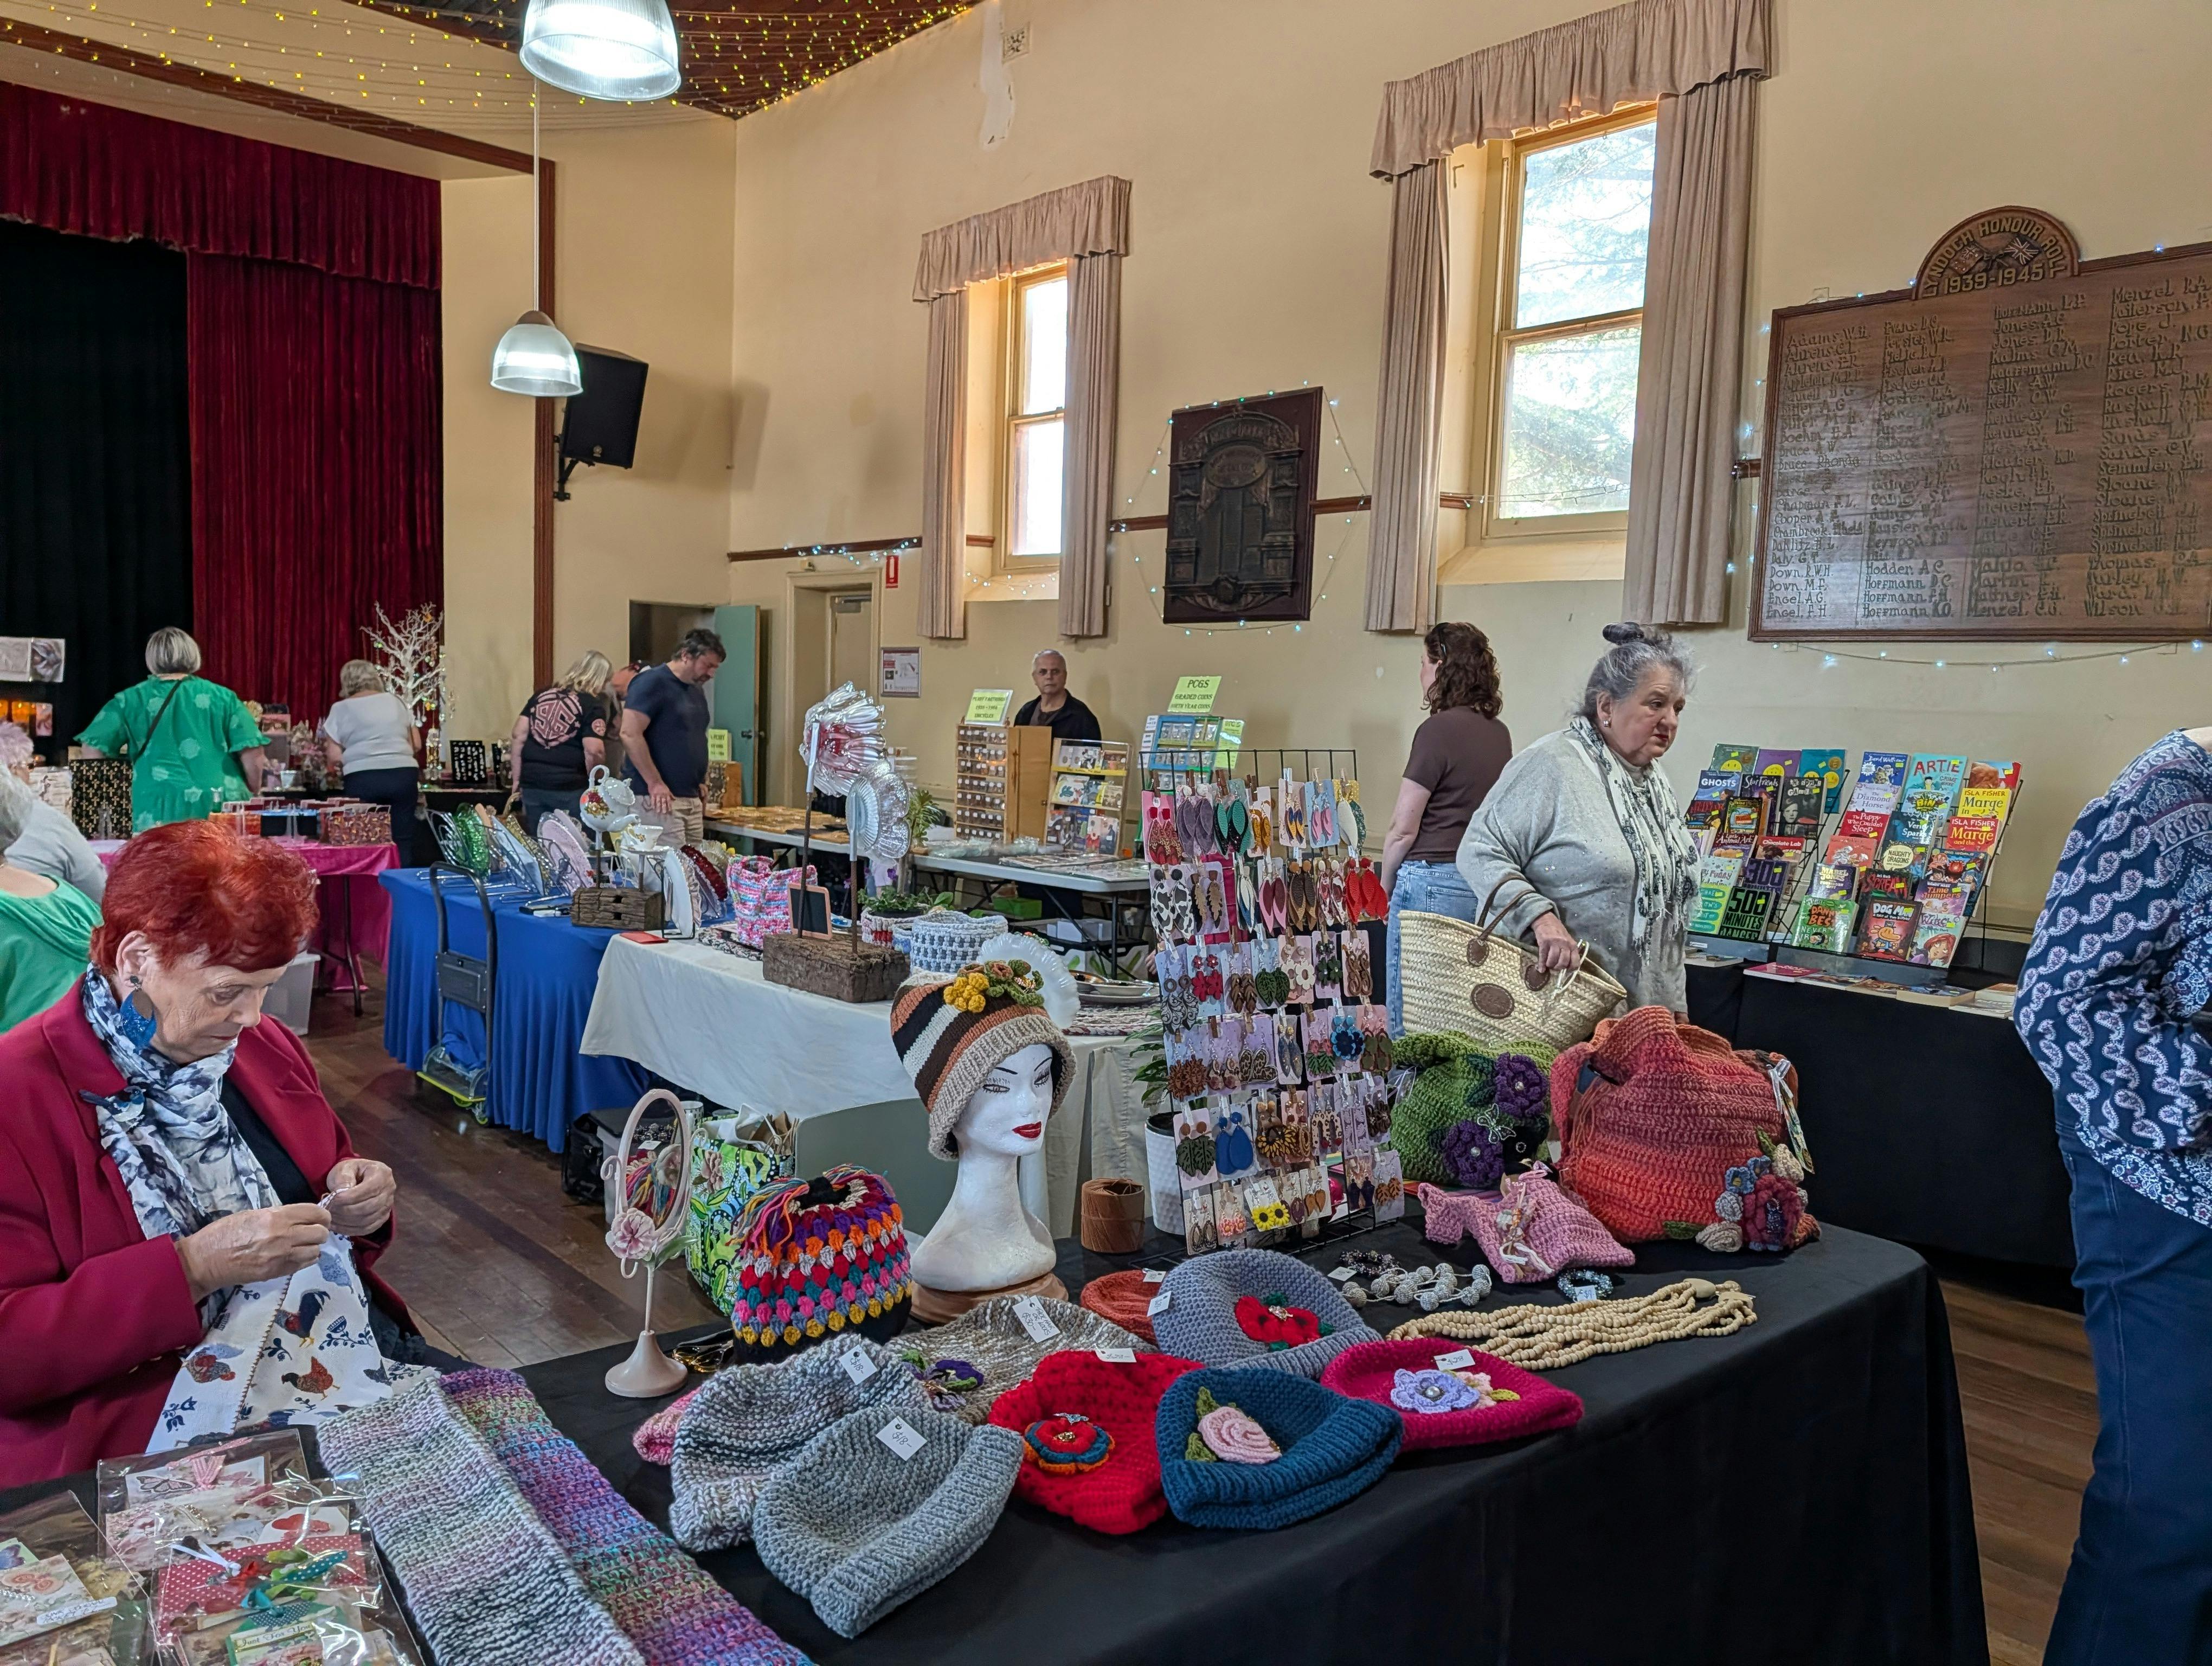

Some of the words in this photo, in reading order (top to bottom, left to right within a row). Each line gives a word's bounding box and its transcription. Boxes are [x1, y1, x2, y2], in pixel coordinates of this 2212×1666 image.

[1922, 230, 1974, 297] LYNDOCH
[1979, 217, 2044, 240] HONOUR
[2041, 236, 2066, 278] ROLL
[1944, 263, 2043, 294] 1939-1945
[1187, 679, 1210, 688] PCGS
[1913, 759, 1963, 777] ARTIE
[1701, 778, 1737, 787] GHOSTS
[1856, 793, 1891, 803] Diamond
[1862, 800, 1884, 809] Horse
[1962, 797, 2003, 811] Marge
[1860, 813, 1881, 822] Puppy
[1851, 825, 1873, 834] Sleep
[1950, 826, 1994, 844] Marge
[1888, 850, 1912, 858] NAUGHTY
[1728, 888, 1772, 915] 500
[1873, 902, 1893, 913] DOG
[1723, 912, 1763, 930] MINUTES
[1801, 925, 1828, 934] NEVER
[239, 1638, 260, 1648] Just
